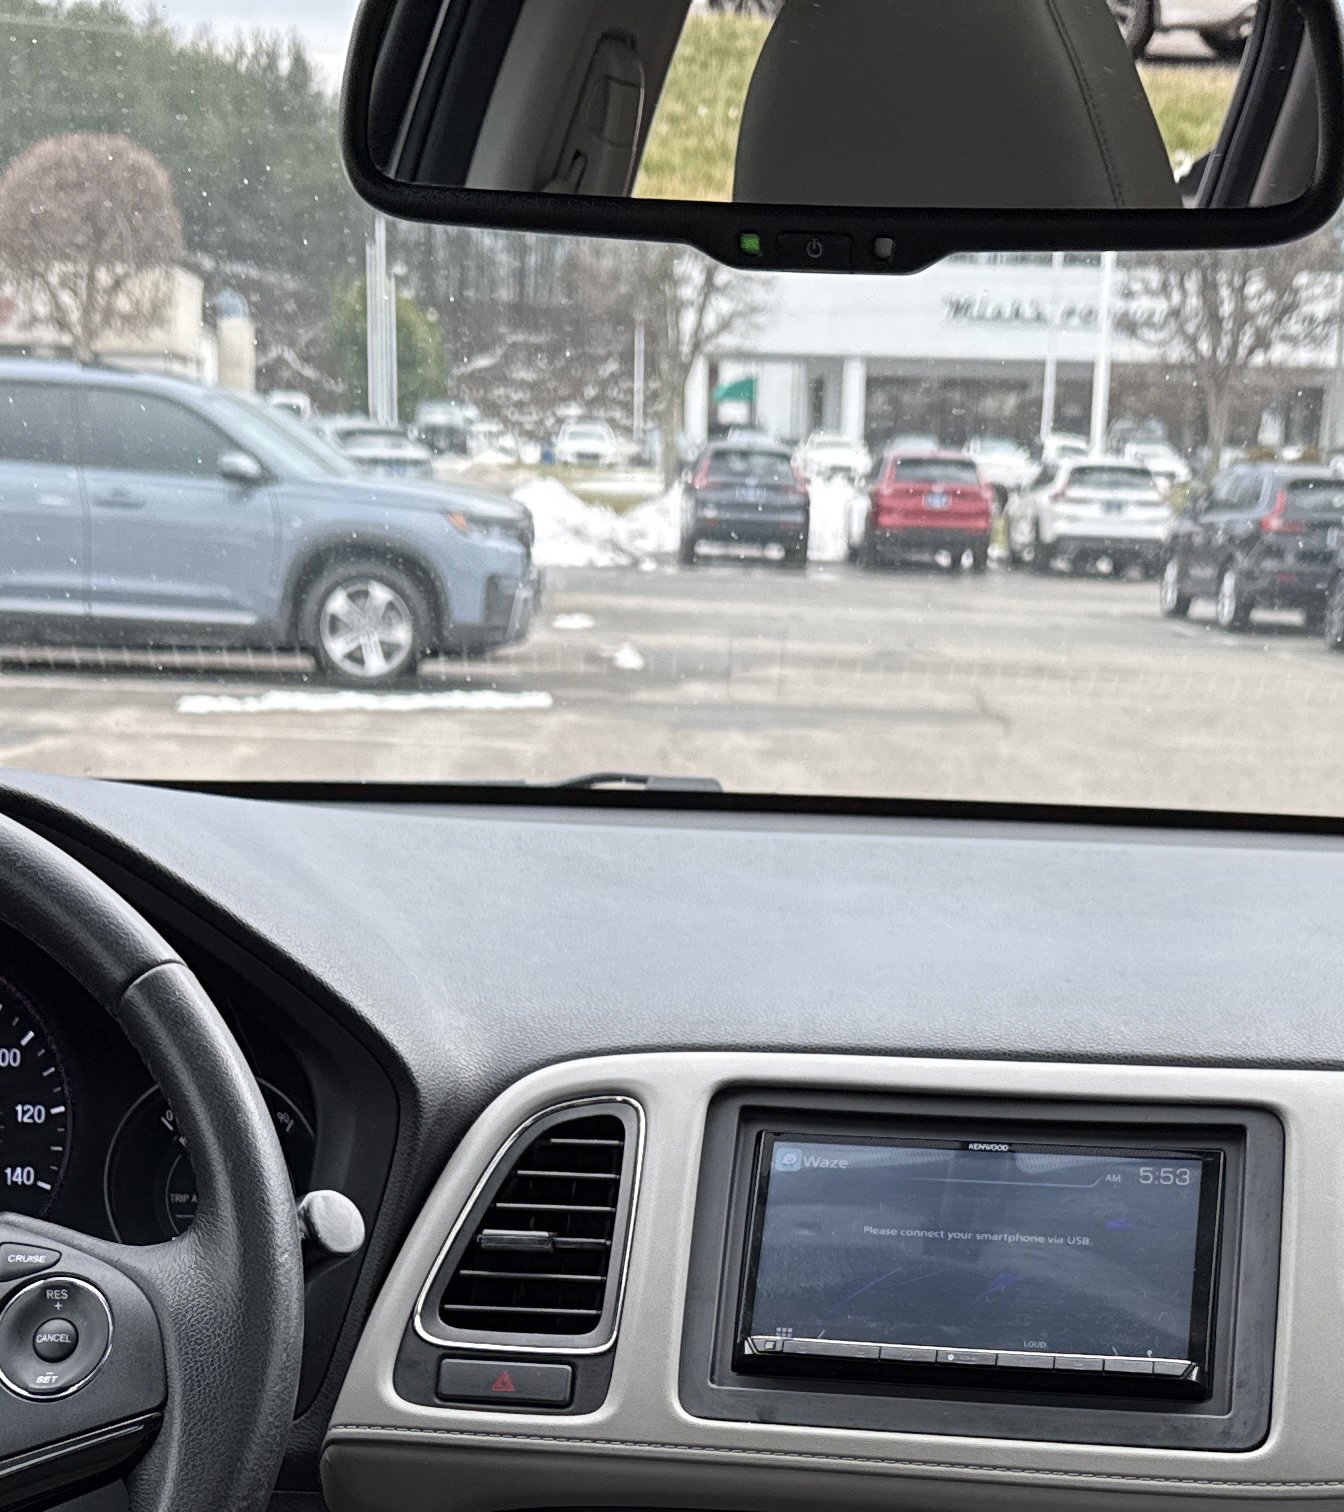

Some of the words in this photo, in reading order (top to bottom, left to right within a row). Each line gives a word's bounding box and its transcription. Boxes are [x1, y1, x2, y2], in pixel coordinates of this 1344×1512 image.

[15, 1104, 45, 1123] 120
[968, 1143, 1009, 1152] KENWOOD
[804, 1155, 848, 1169] Waze
[5, 1167, 35, 1186] 140
[1105, 1174, 1121, 1183] AM
[1139, 1167, 1191, 1186] 5:53
[864, 1225, 897, 1237] Please
[900, 1229, 944, 1240] connect
[947, 1231, 972, 1241] your
[976, 1233, 1045, 1246] smartphone
[1048, 1235, 1064, 1244] via
[7, 1254, 47, 1263] CRUISE
[46, 1289, 68, 1300] RES
[36, 1333, 72, 1343] CANCEL
[36, 1375, 59, 1384] SET
